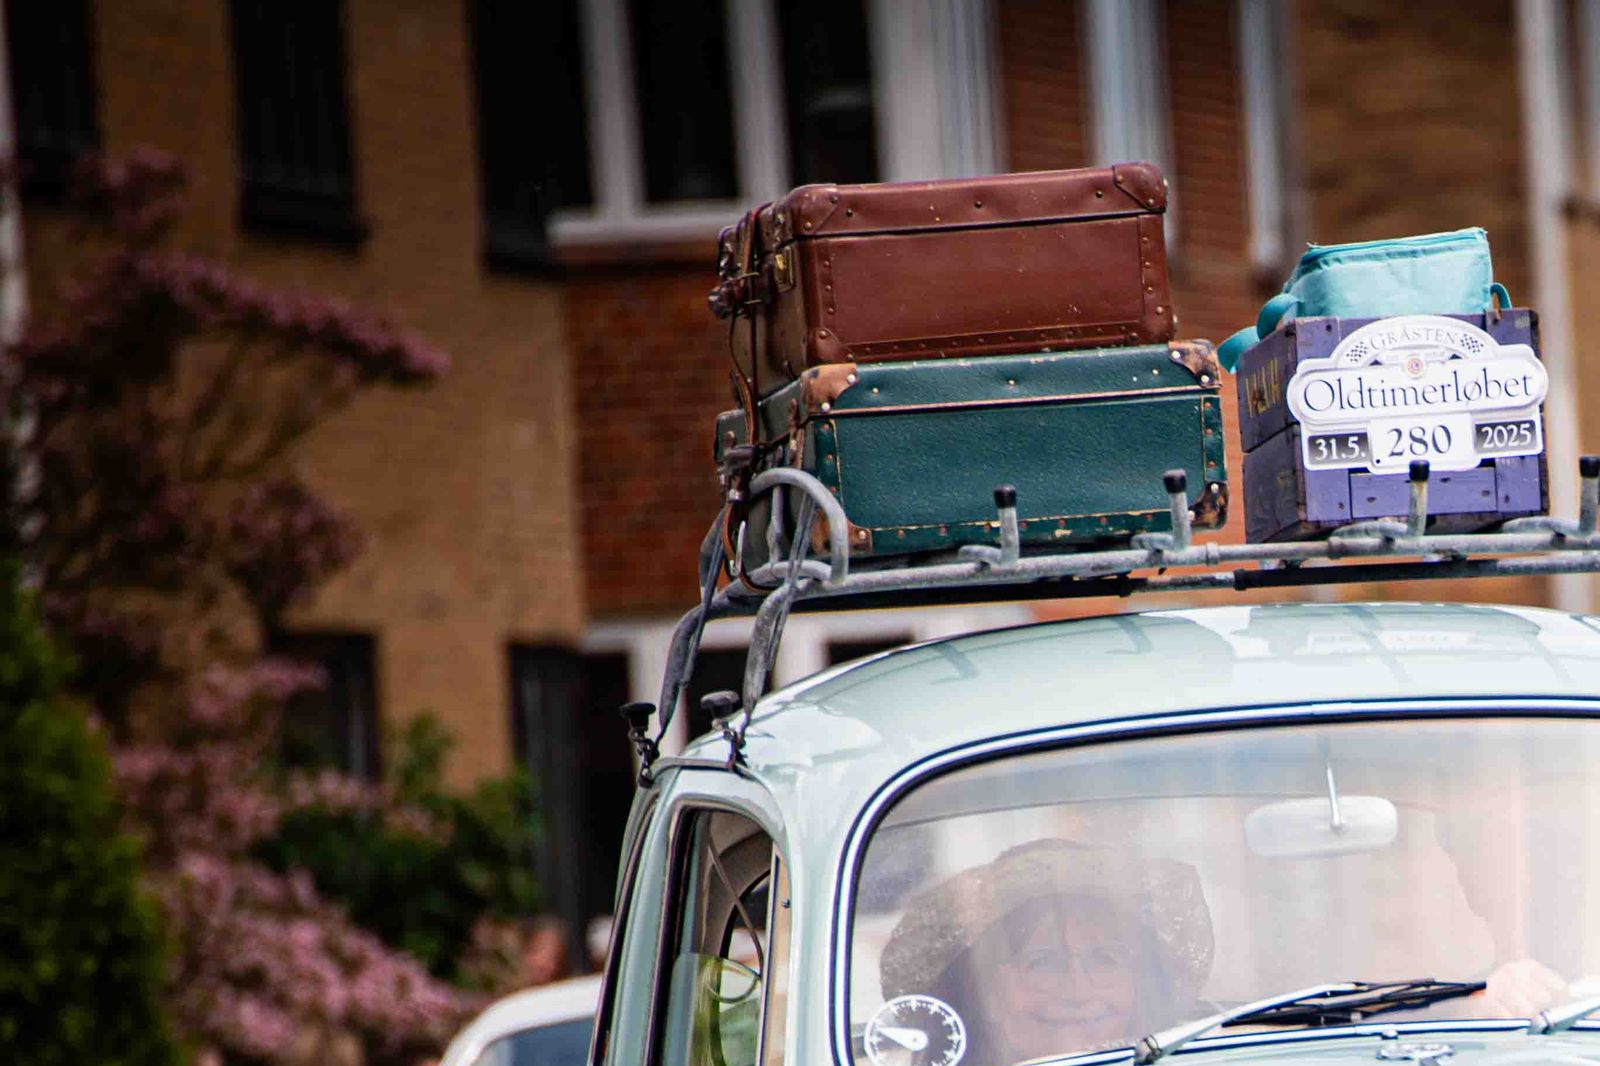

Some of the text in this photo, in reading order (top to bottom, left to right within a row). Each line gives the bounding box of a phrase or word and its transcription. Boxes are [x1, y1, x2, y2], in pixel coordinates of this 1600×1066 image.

[1303, 367, 1533, 412] Oldtimerløbet
[1314, 422, 1532, 461] 31.5. 280 2025
